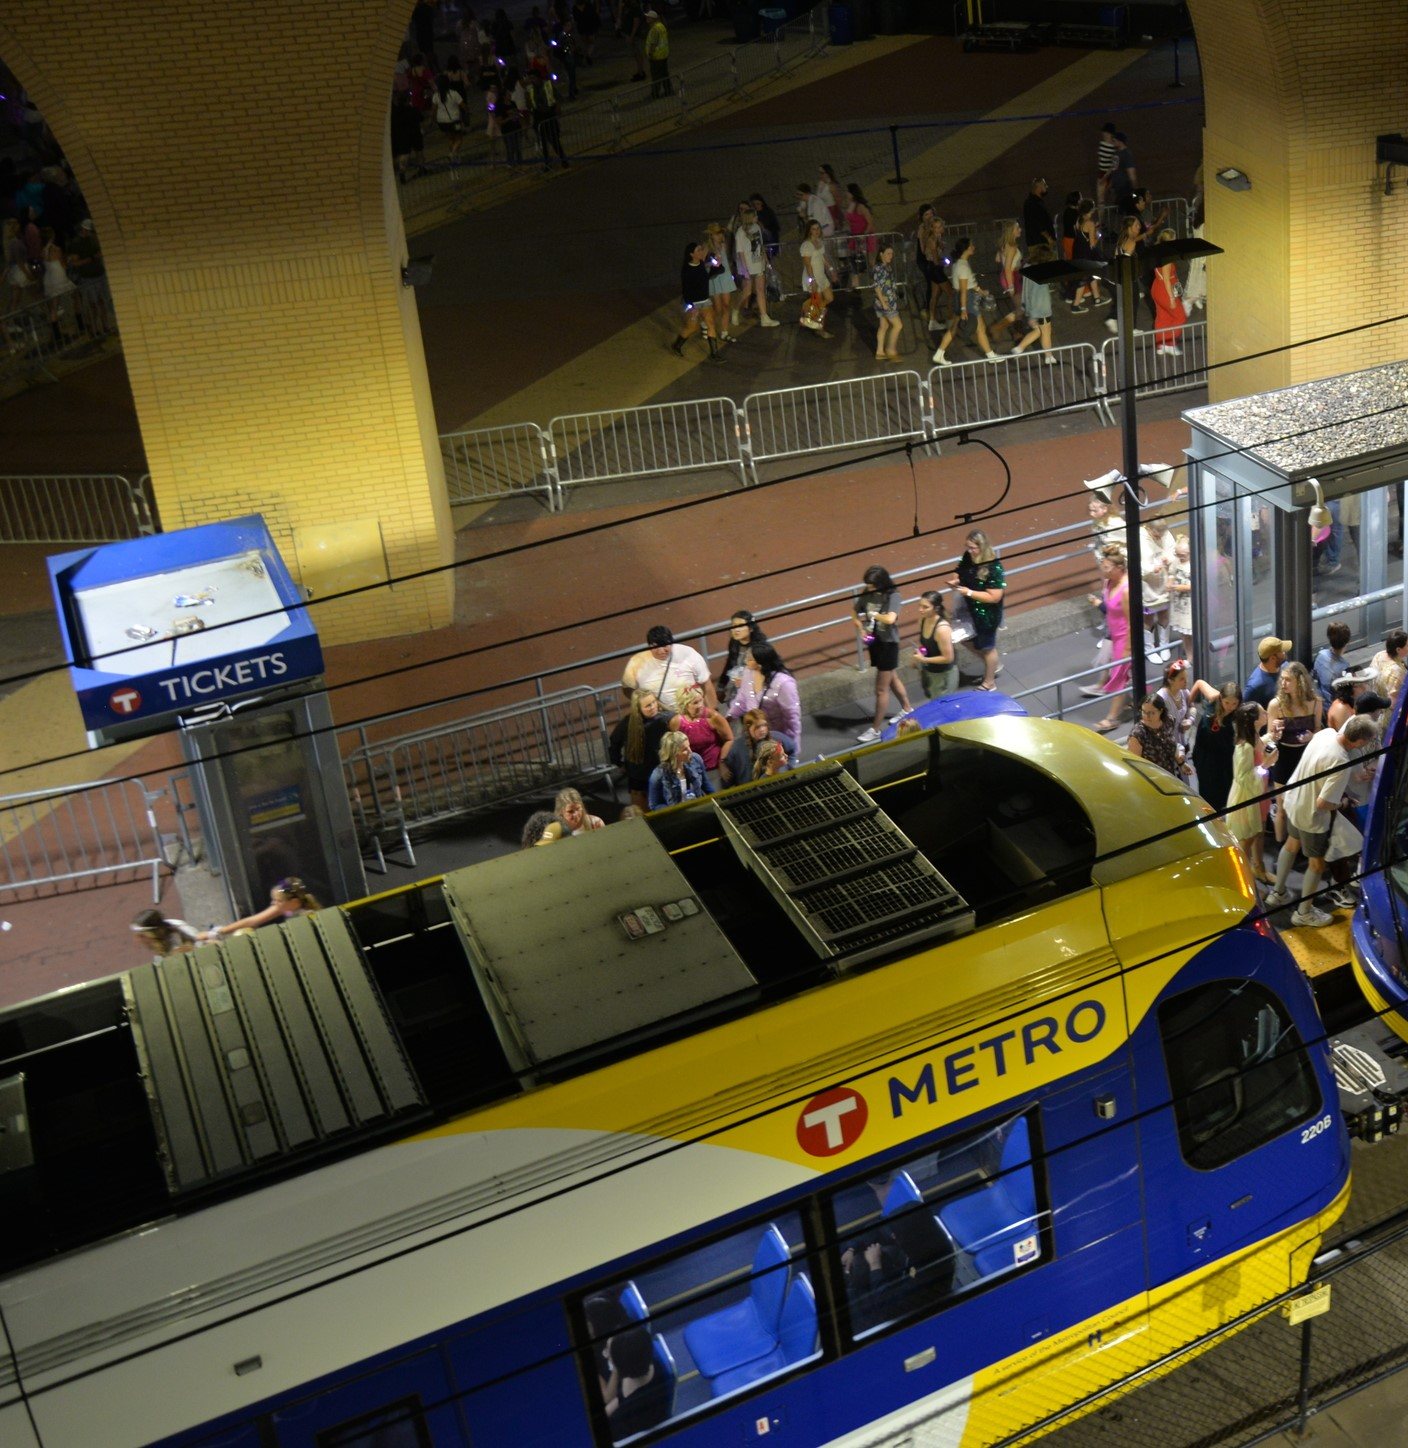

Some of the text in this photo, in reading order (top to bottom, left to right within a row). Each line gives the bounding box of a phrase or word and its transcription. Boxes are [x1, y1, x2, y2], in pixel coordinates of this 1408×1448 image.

[158, 651, 288, 701] TICKETS
[887, 999, 1106, 1119] METRO
[1301, 1114, 1332, 1144] 220B
